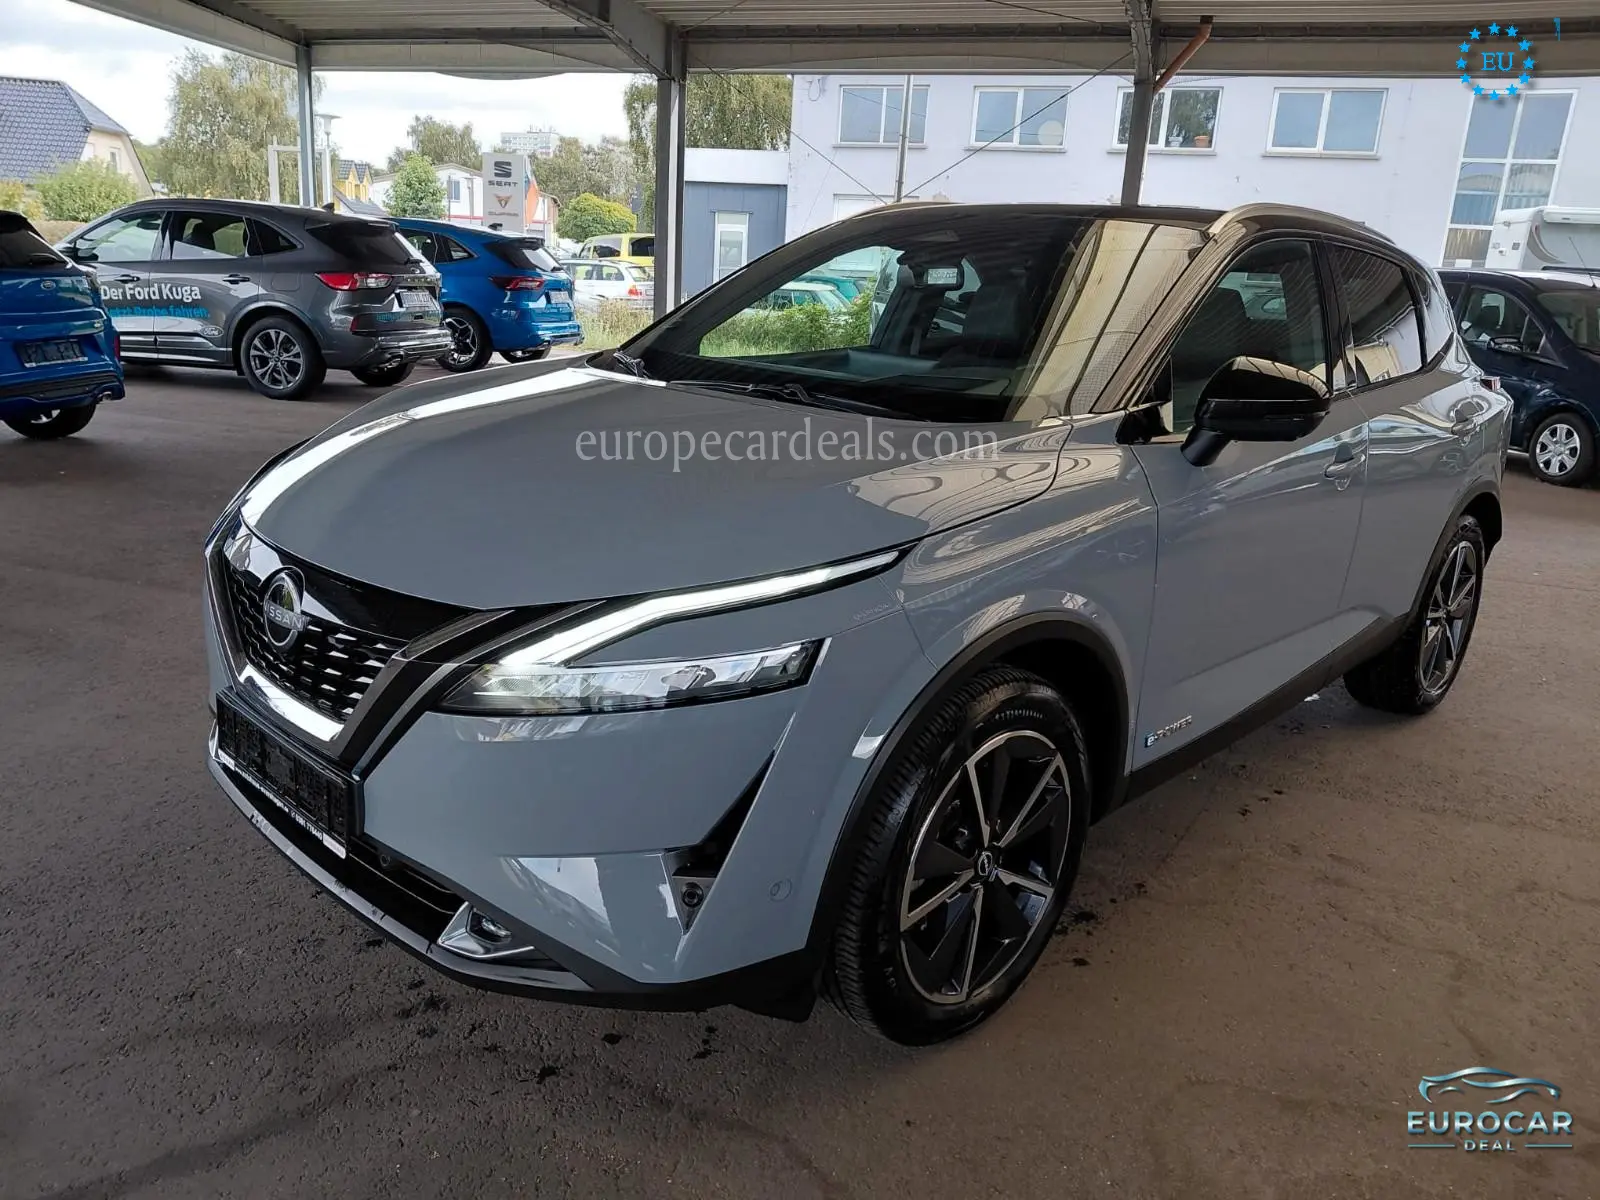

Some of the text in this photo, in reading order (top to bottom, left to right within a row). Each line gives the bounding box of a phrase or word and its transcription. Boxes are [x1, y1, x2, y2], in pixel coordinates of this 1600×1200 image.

[101, 283, 201, 302] Der Ford Kuga
[265, 602, 303, 629] ISSAN
